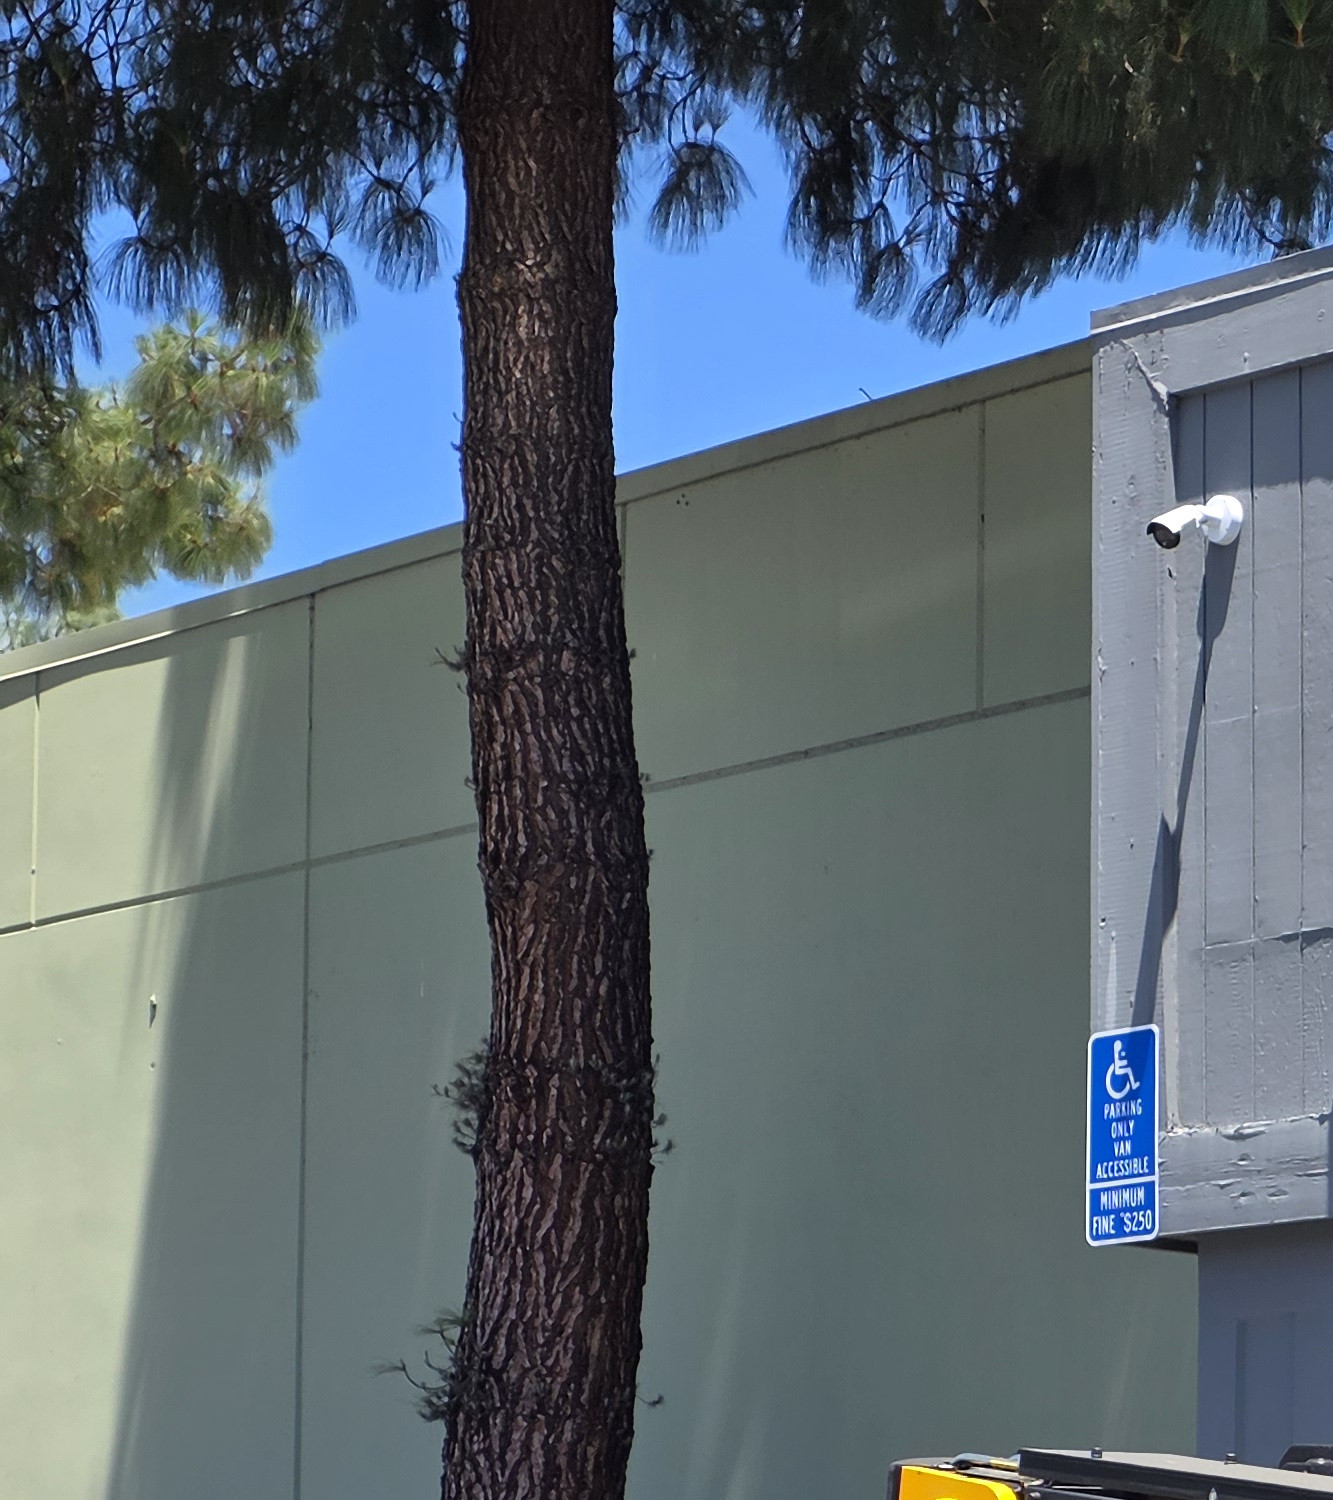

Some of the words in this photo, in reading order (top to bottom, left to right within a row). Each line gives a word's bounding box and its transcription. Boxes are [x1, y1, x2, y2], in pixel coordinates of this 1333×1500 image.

[1104, 1098, 1142, 1120] PARKING
[1111, 1119, 1135, 1139] ONLY
[1114, 1139, 1131, 1157] VAN
[1096, 1156, 1149, 1179] ACCESSIBLE
[1100, 1186, 1145, 1211] MINIMUM
[1093, 1213, 1116, 1236] FINE
